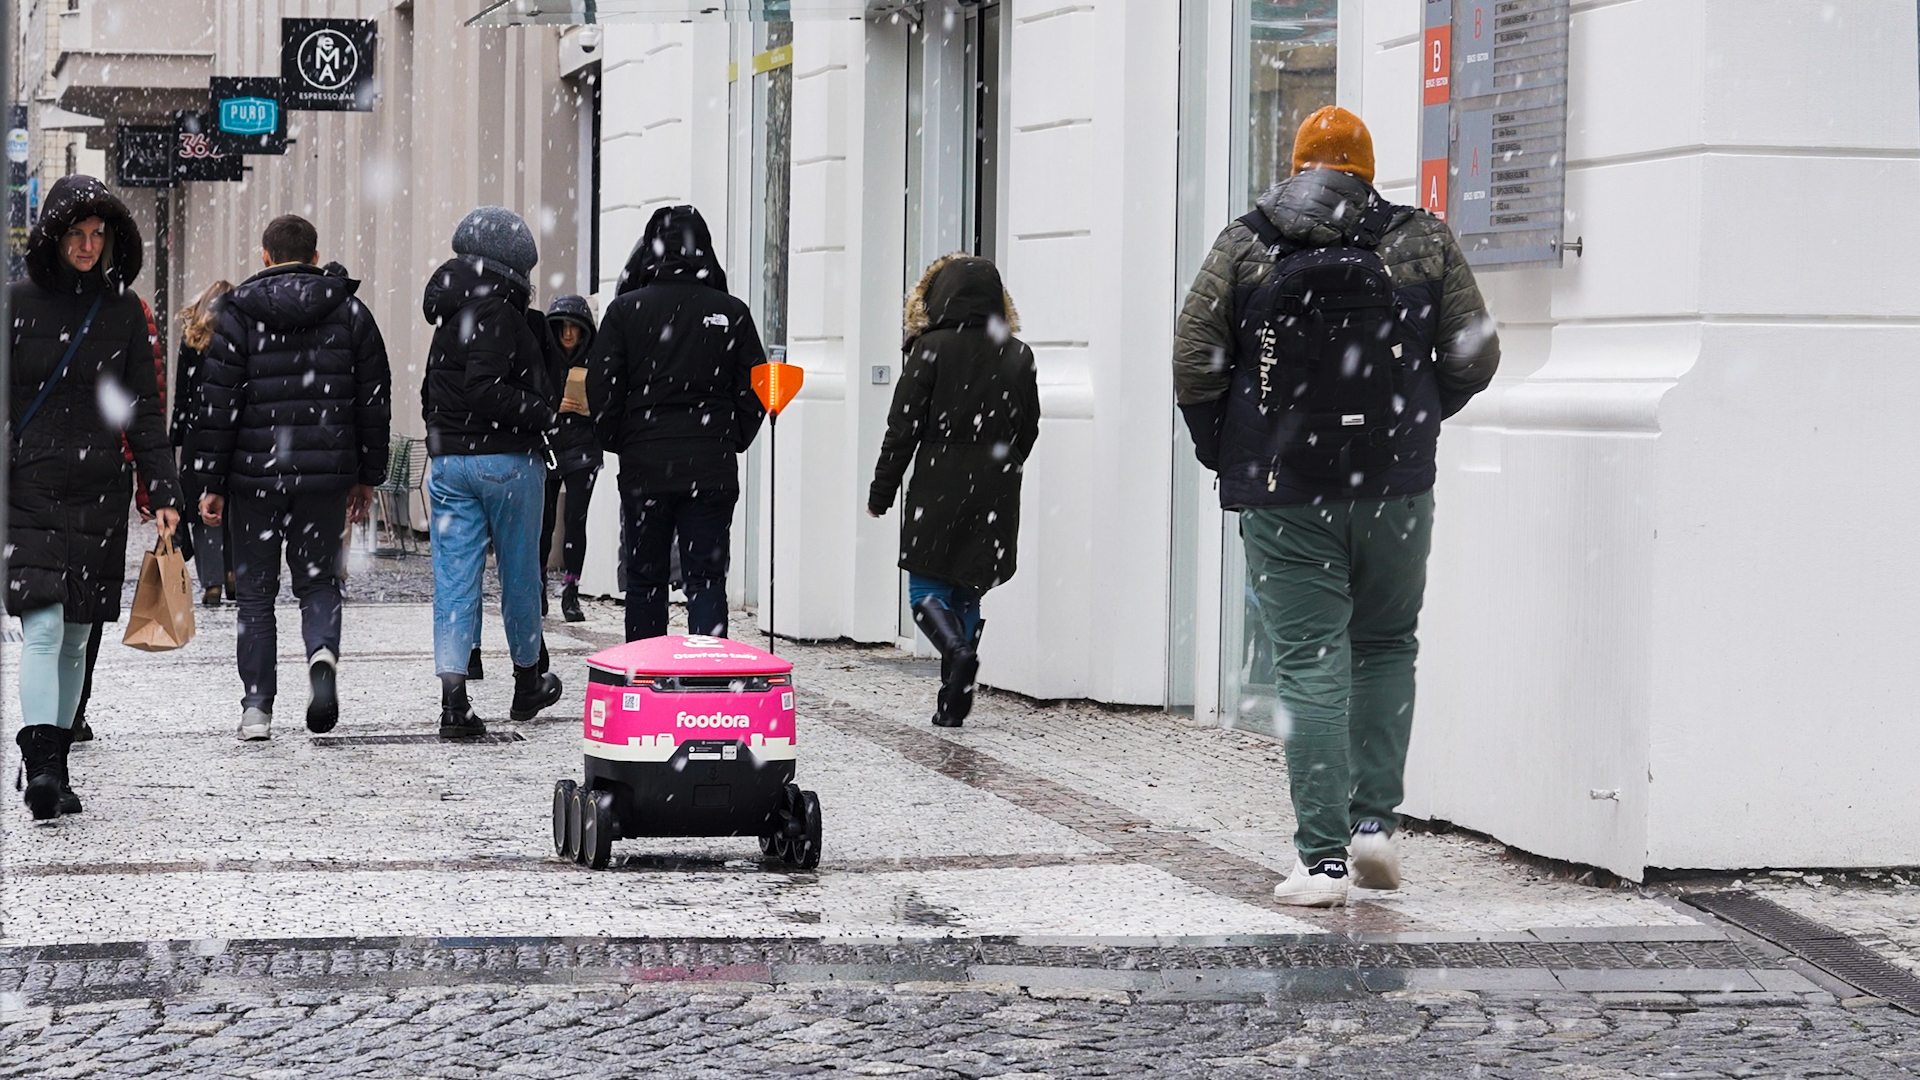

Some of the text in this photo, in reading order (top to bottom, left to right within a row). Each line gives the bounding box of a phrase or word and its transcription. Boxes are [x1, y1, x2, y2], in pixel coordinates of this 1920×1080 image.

[1433, 40, 1442, 73] B
[299, 92, 338, 100] ESPRESSO
[231, 104, 266, 120] PURO
[1429, 175, 1439, 208] A
[677, 711, 749, 728] foodora
[1324, 864, 1343, 872] FILA
